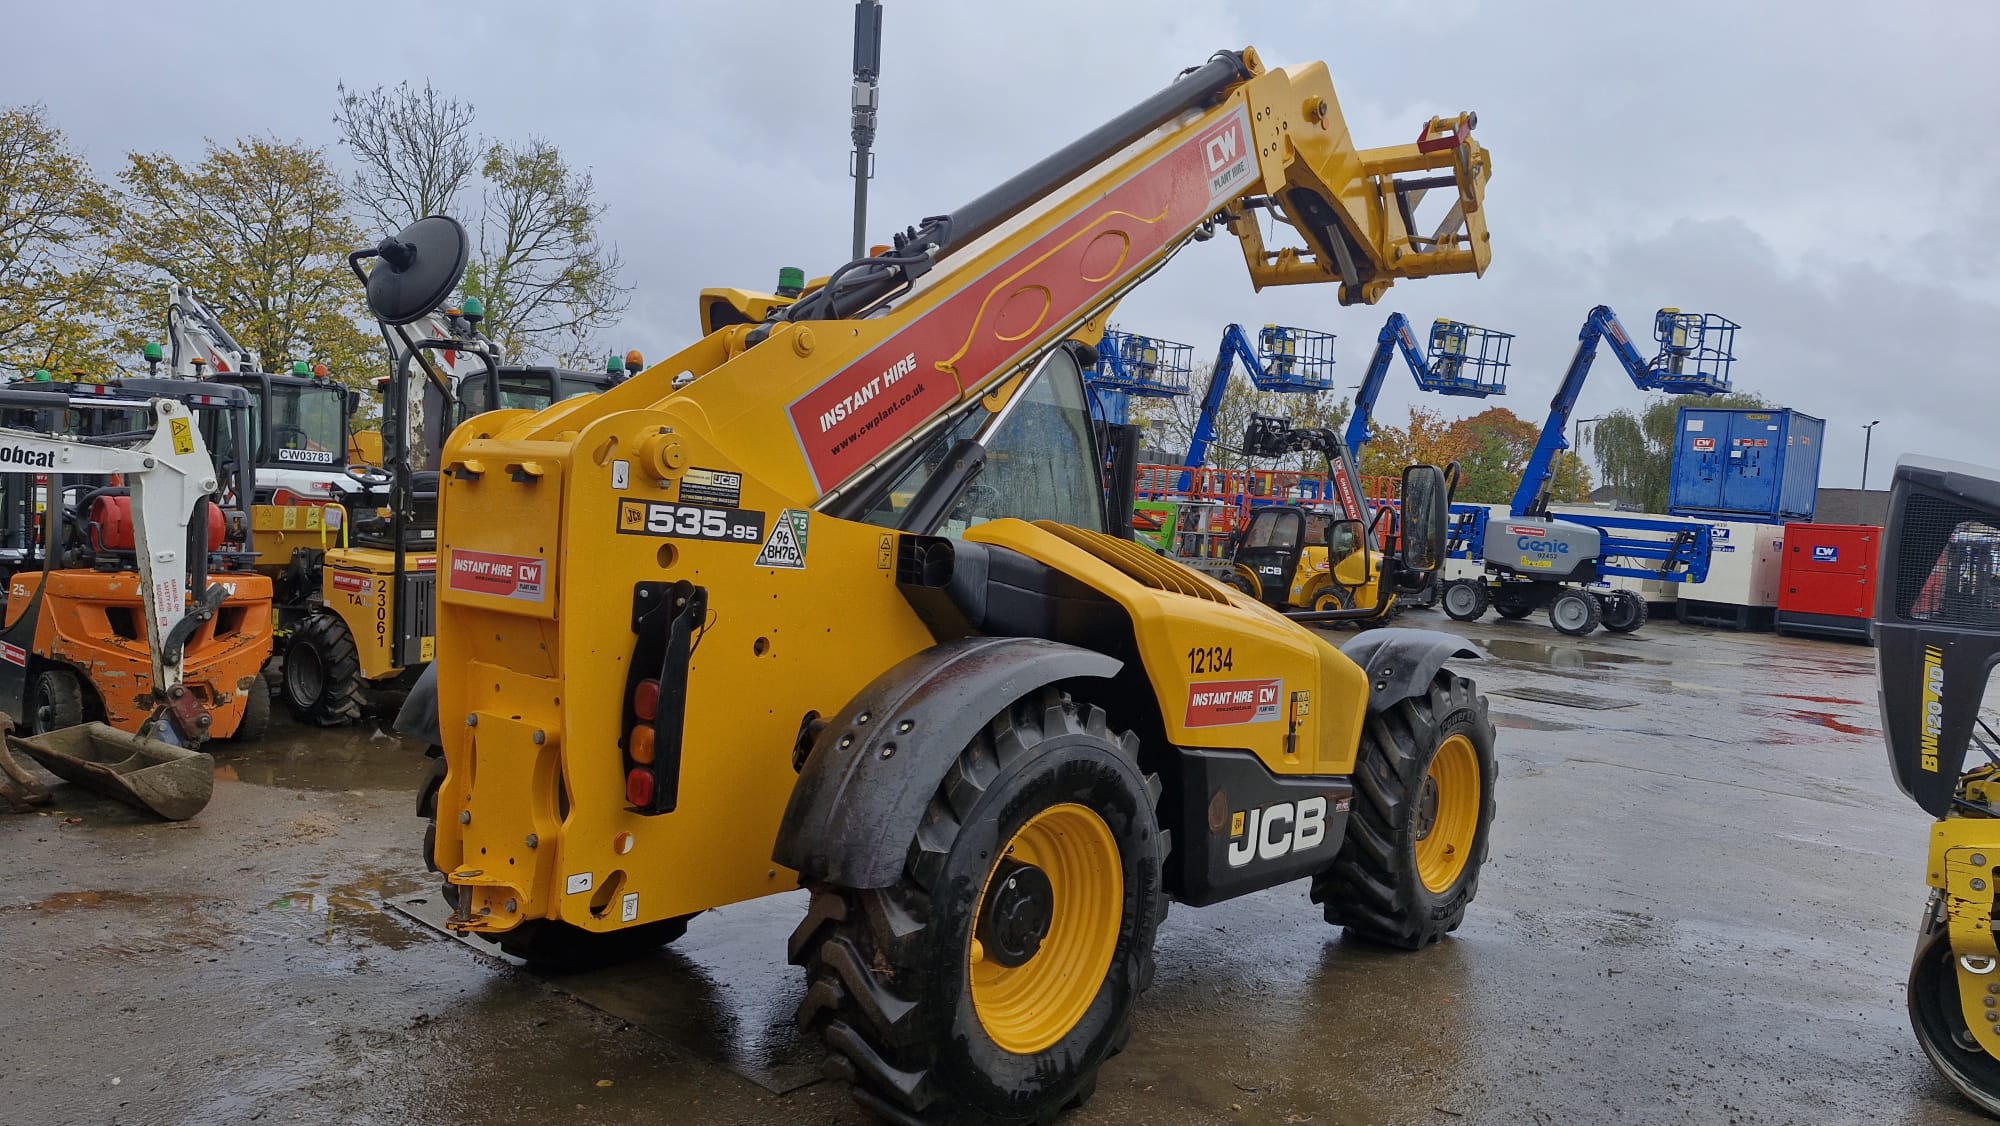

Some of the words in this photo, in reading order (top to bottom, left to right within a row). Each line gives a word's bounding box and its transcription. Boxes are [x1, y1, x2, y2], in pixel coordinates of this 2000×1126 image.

[1206, 126, 1236, 172] CW
[1213, 169, 1232, 191] PLANT
[1231, 161, 1245, 178] HIRE
[820, 376, 881, 433] INSTANT
[883, 352, 917, 388] HIRE
[831, 383, 926, 455] www.cwplant.co.uk
[0, 445, 55, 468] obcat
[280, 449, 330, 463] CW03783
[714, 474, 738, 486] JCB
[625, 507, 642, 524] JCB
[647, 503, 758, 540] 535-95
[776, 530, 789, 545] 96
[1517, 536, 1569, 553] Genie
[767, 545, 796, 561] BH7G
[1815, 547, 1834, 556] CW
[453, 559, 490, 575] INSTANT
[490, 563, 513, 577] HIRE
[519, 565, 538, 582] CW
[1258, 564, 1282, 575] JCB
[12, 584, 25, 596] 25
[376, 580, 387, 647] 23061
[1187, 647, 1233, 674] 12134
[1928, 666, 1944, 697] AD
[1192, 692, 1232, 706] INSTANT
[1232, 690, 1253, 704] HIRE
[1259, 687, 1276, 703] CW
[1926, 701, 1942, 735] 120
[1921, 734, 1939, 773] BW
[1228, 796, 1327, 867] JCB
